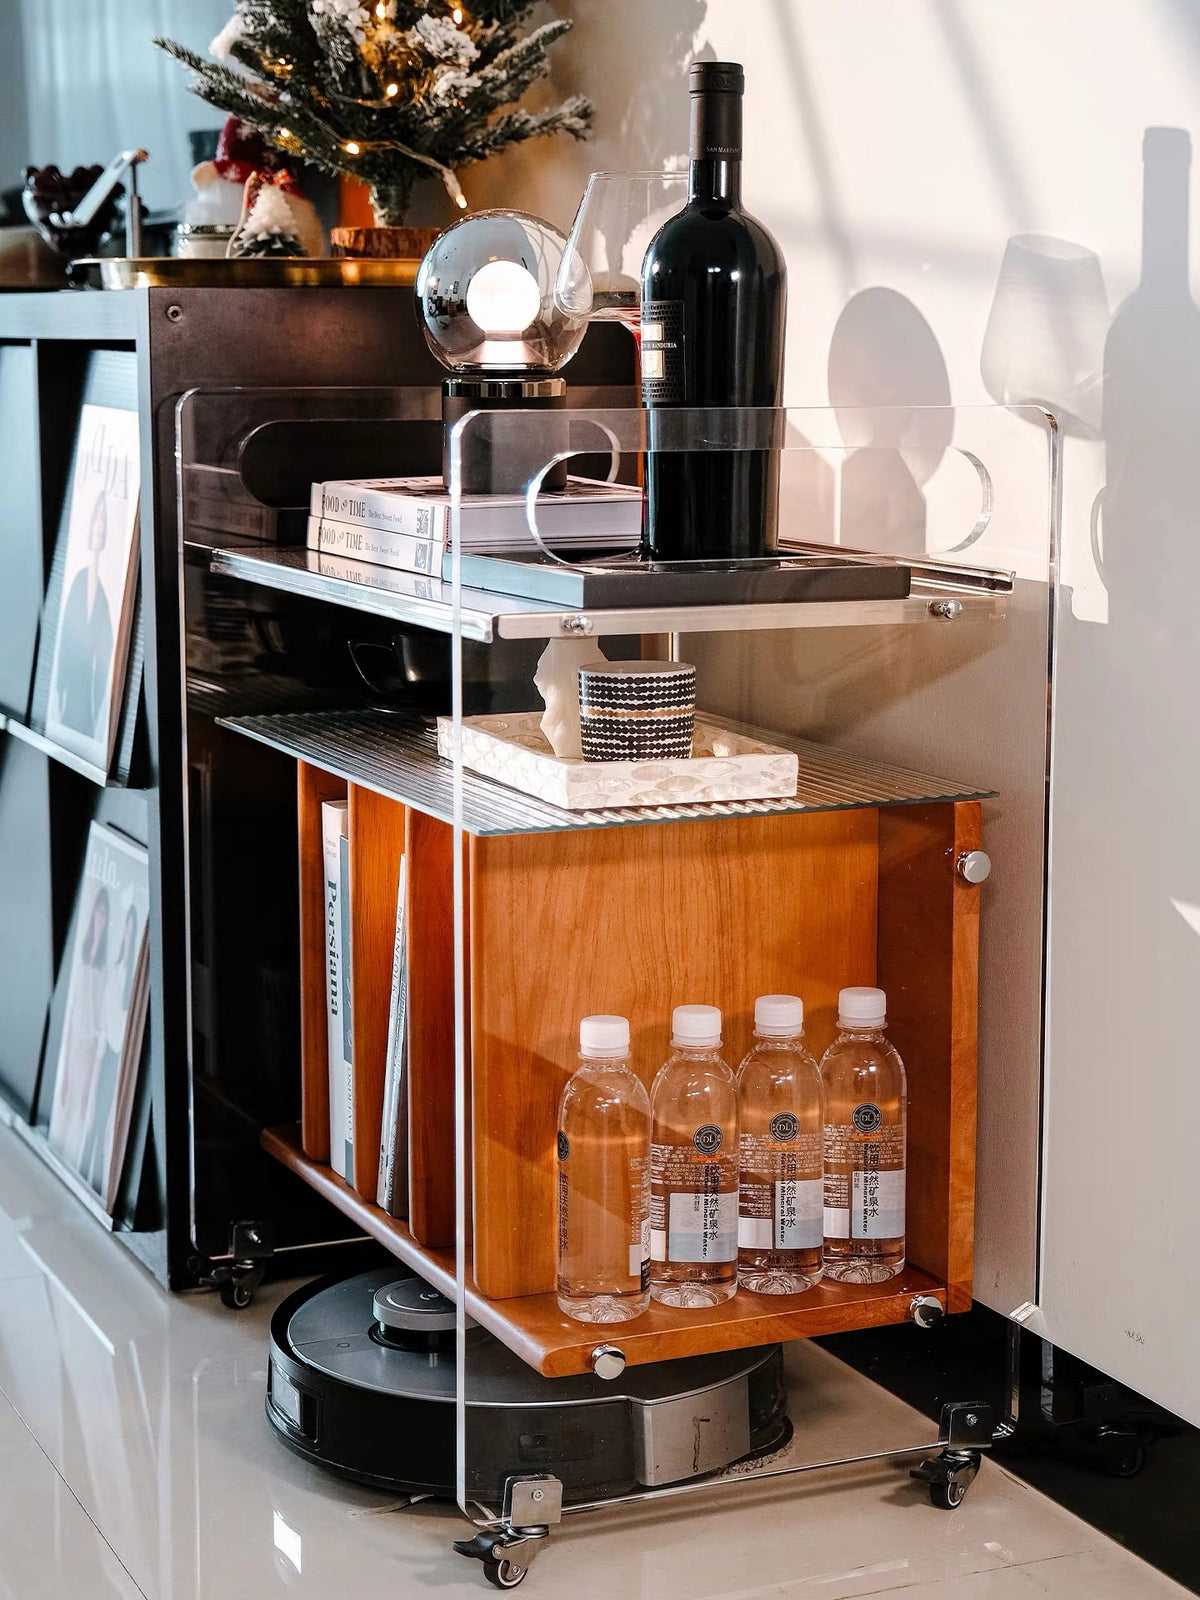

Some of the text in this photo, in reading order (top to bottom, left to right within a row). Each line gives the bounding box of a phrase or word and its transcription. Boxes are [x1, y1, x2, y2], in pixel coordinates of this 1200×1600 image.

[346, 532, 363, 551] TIME
[349, 500, 366, 518] TIME
[327, 880, 339, 1016] Persiana
[708, 1165, 720, 1241] 饮用天然矿泉水
[786, 1153, 797, 1228] 饮用天然矿泉水
[869, 1143, 879, 1218] 饮用天然矿泉水
